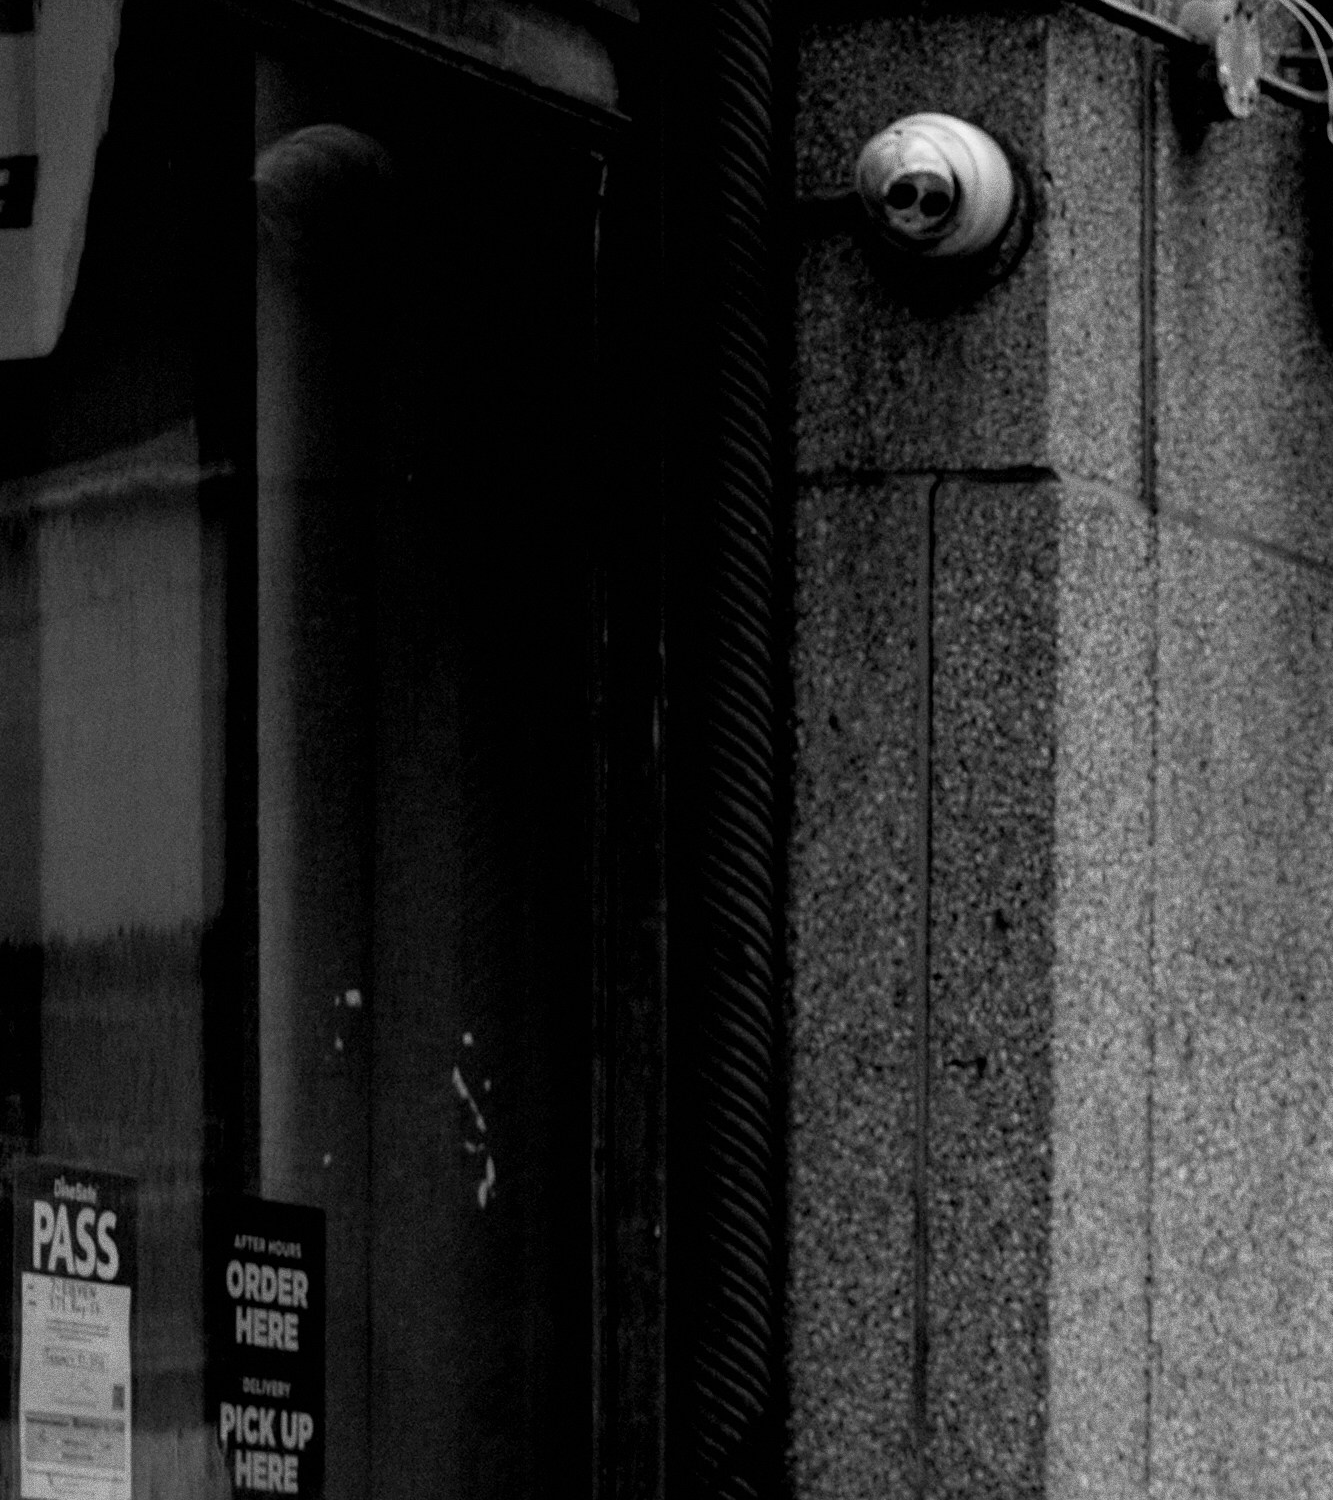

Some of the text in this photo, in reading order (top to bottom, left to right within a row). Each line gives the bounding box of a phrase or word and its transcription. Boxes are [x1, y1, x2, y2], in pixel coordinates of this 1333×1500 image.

[32, 1199, 119, 1281] PASS
[233, 1233, 302, 1259] AFTER HOURS
[226, 1258, 309, 1310] ORDER
[235, 1304, 300, 1353] HERE
[242, 1375, 292, 1399] DELIVERY
[219, 1400, 314, 1451] PICK UP
[234, 1448, 299, 1494] HERE
